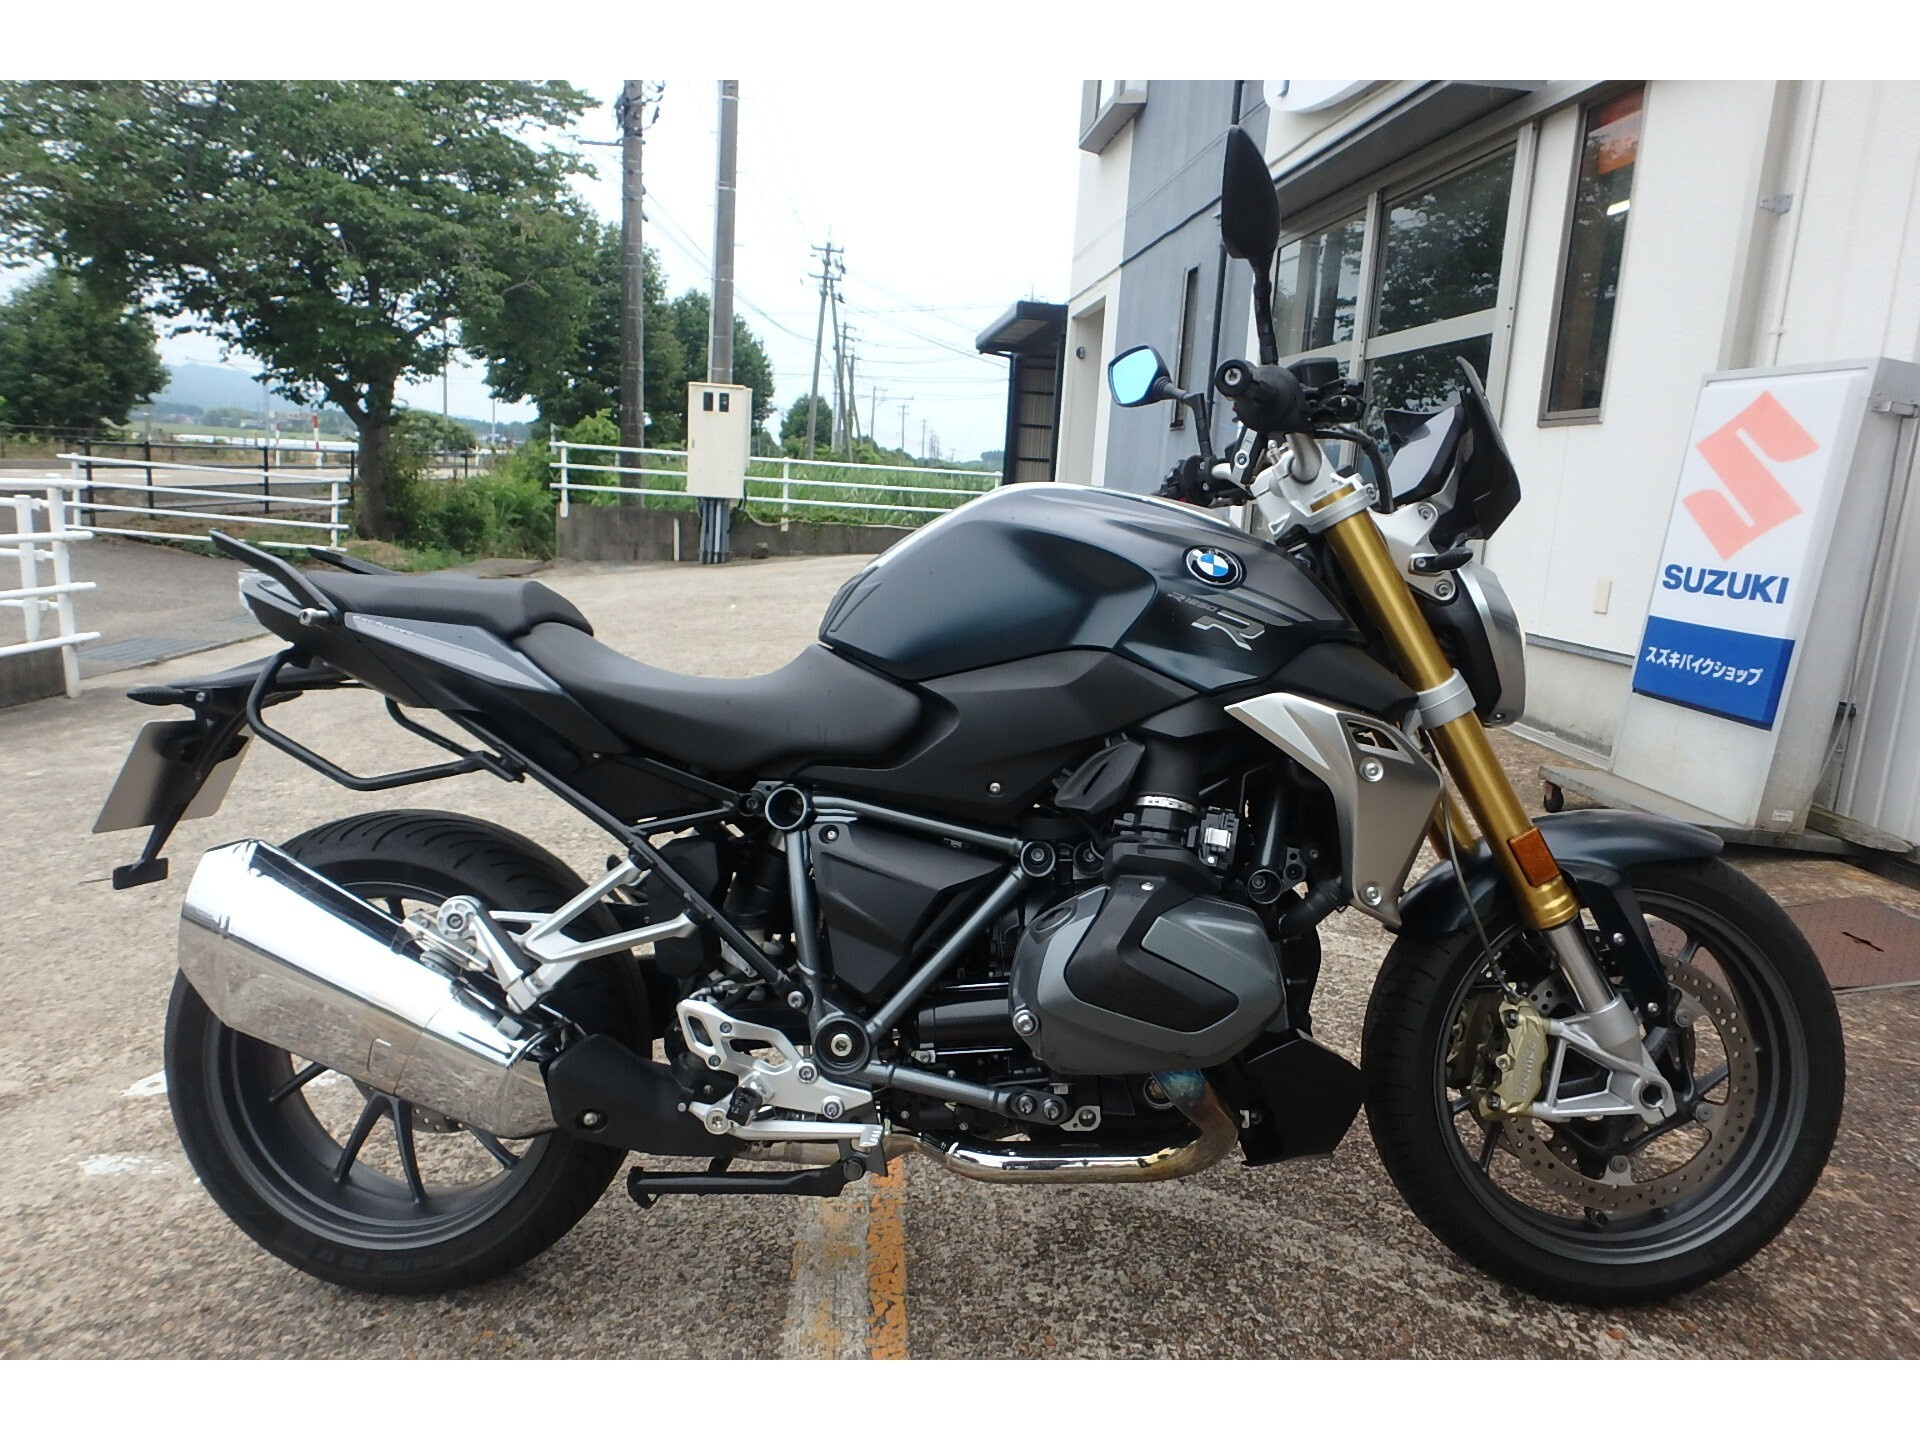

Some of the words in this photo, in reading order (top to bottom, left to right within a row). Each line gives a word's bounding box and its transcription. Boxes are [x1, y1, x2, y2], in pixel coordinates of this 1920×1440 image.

[1662, 564, 1790, 604] SUZUKI
[1645, 646, 1764, 686] スズキバイクショップ
